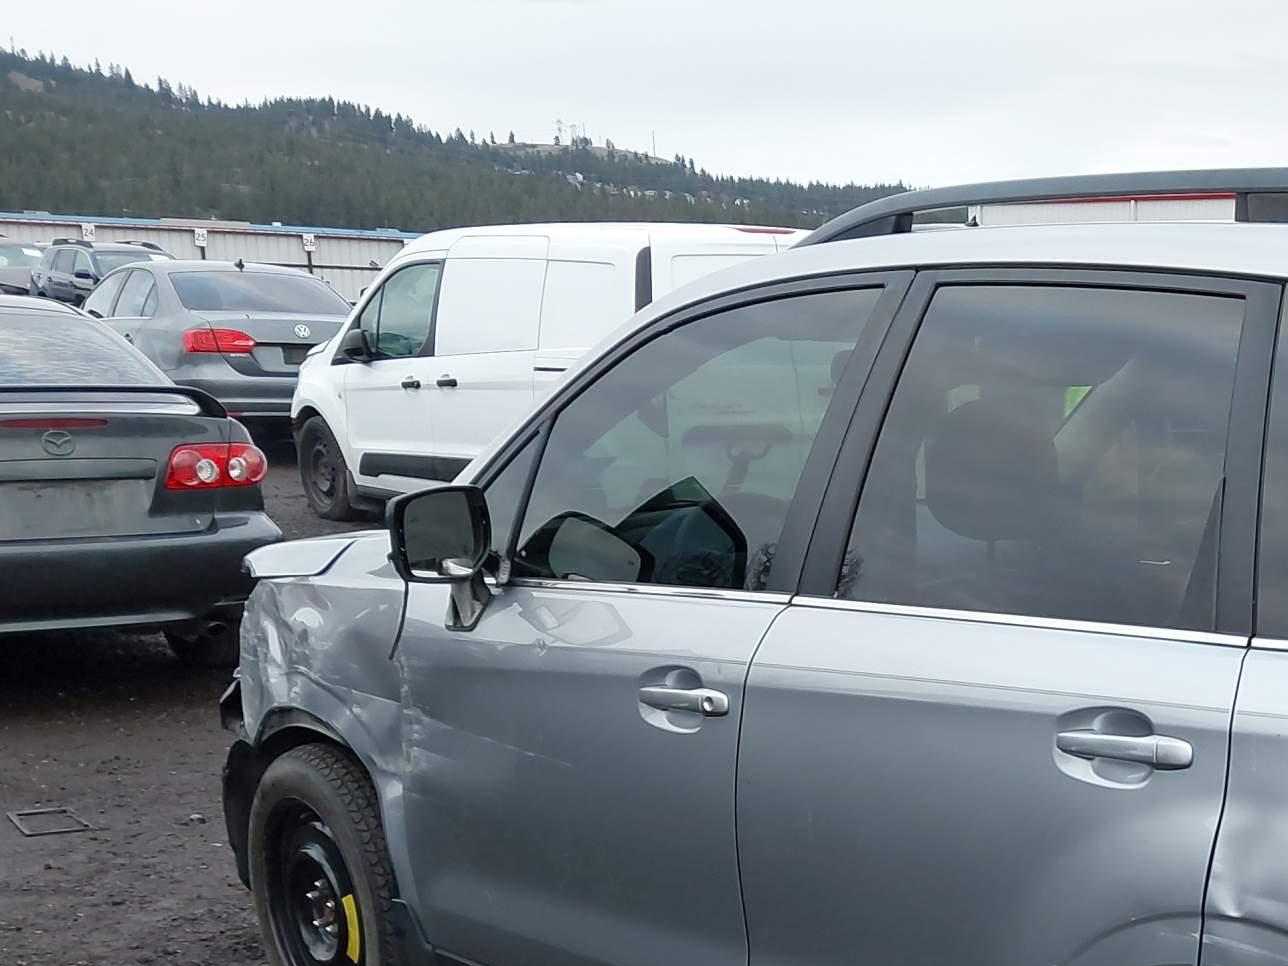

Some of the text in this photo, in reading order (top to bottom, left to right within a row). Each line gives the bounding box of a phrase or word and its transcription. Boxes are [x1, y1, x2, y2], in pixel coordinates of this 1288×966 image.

[83, 227, 94, 237] 24
[195, 232, 206, 242] 25
[303, 237, 315, 247] 26
